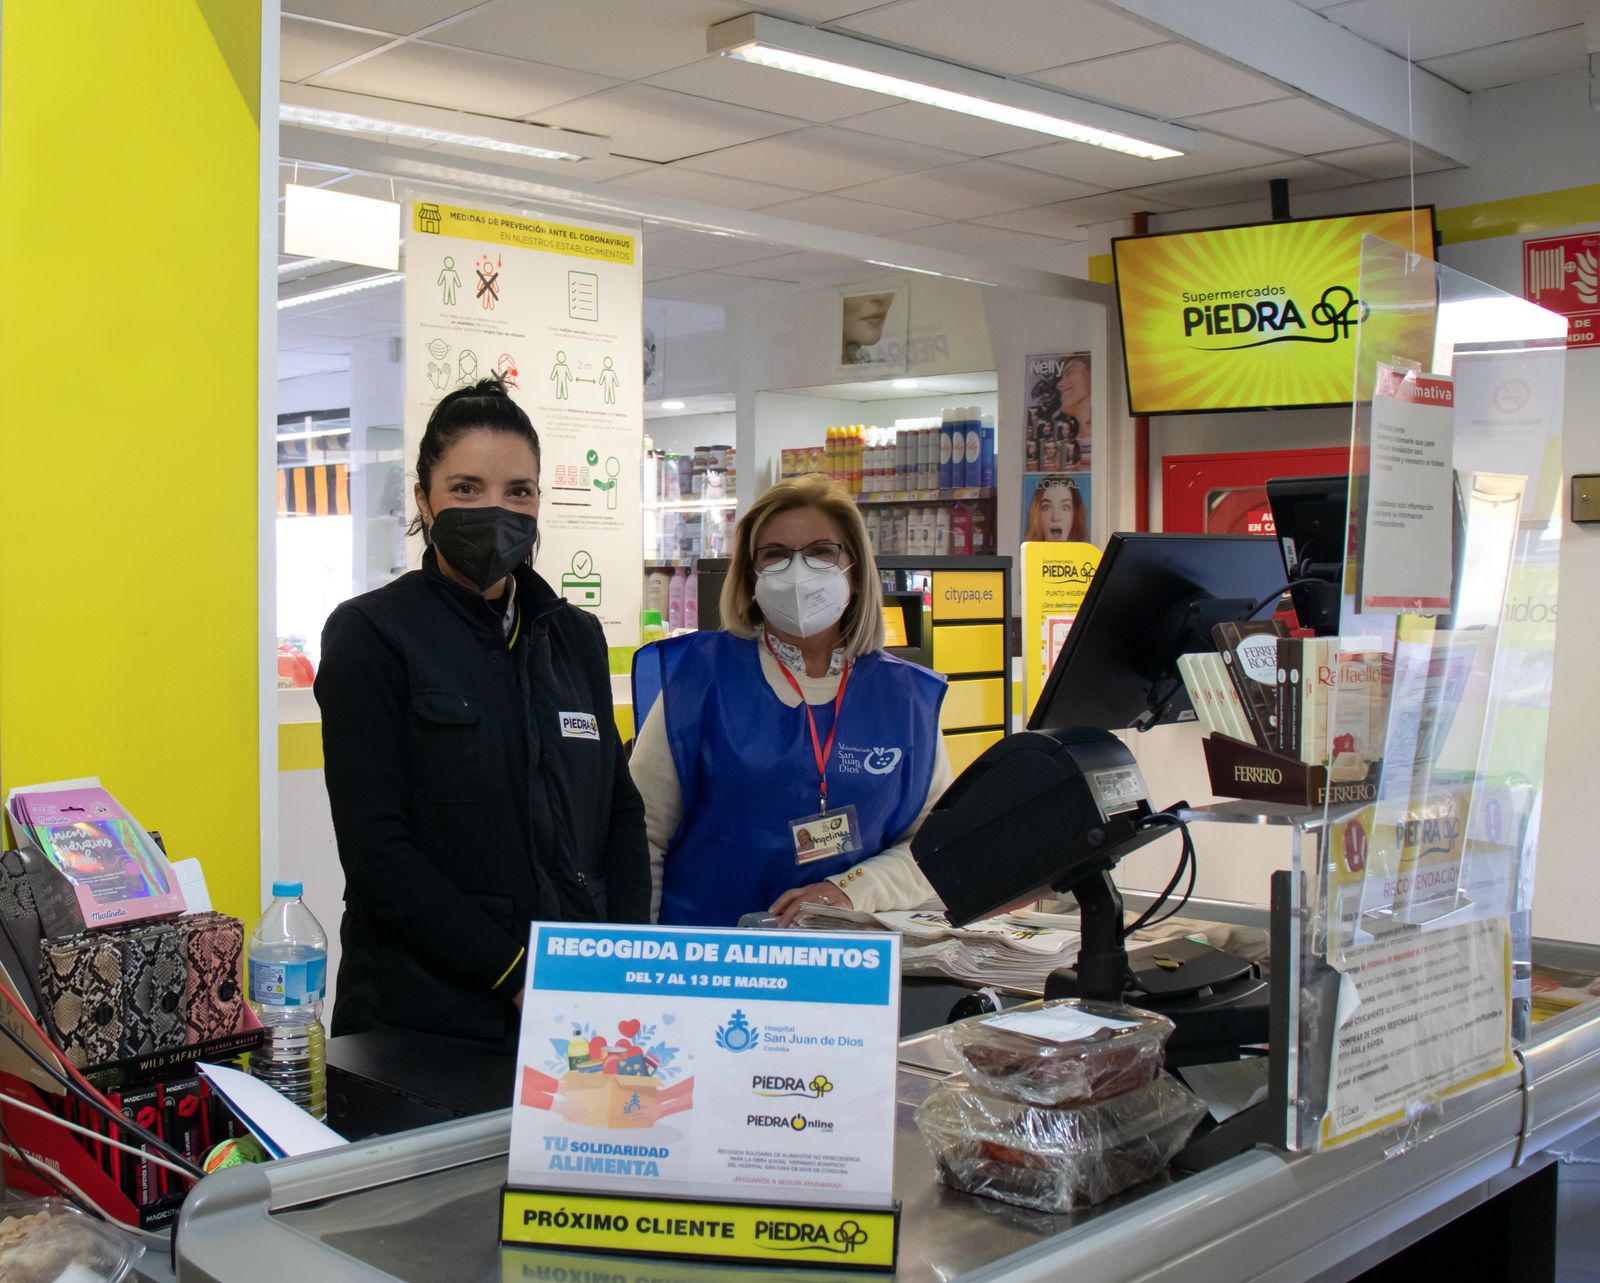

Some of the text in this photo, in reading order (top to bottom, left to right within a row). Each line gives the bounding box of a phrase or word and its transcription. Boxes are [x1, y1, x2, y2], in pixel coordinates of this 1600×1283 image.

[449, 211, 630, 249] MEDIDAS DE PREVENCIÓN ANTE EL CORONAVIRUS
[500, 231, 631, 261] EN NUESTROS ESTABLECIMIENTOS
[1182, 284, 1287, 304] Supermercados
[1574, 319, 1592, 328] DE
[577, 361, 584, 370] 2
[1030, 359, 1065, 378] Nelly
[945, 586, 993, 605] citypaq.es
[1318, 662, 1382, 687] Raffaello
[838, 750, 854, 759] San
[841, 758, 861, 766] Juan
[839, 763, 860, 774] Dios
[1233, 765, 1283, 785] FERRERO
[1317, 783, 1377, 804] FERRERO
[547, 936, 881, 969] RECOGIDA DE ALIMENTOS
[625, 971, 788, 989] DEL 7 AL 13 DE MARZO
[764, 1025, 795, 1034] Hospital
[763, 1032, 865, 1047] San Juan de Dios
[140, 1048, 202, 1071] WILD SAFARI
[166, 1080, 199, 1094] MAGICSTUDIO
[123, 1091, 157, 1104] MAGICSTUDIO
[542, 1135, 670, 1159] TU SOLIDARIDAD
[548, 1153, 660, 1177] ALIMENTA
[523, 1207, 629, 1233] PRÓXIMO
[634, 1215, 735, 1240] CLIENTE
